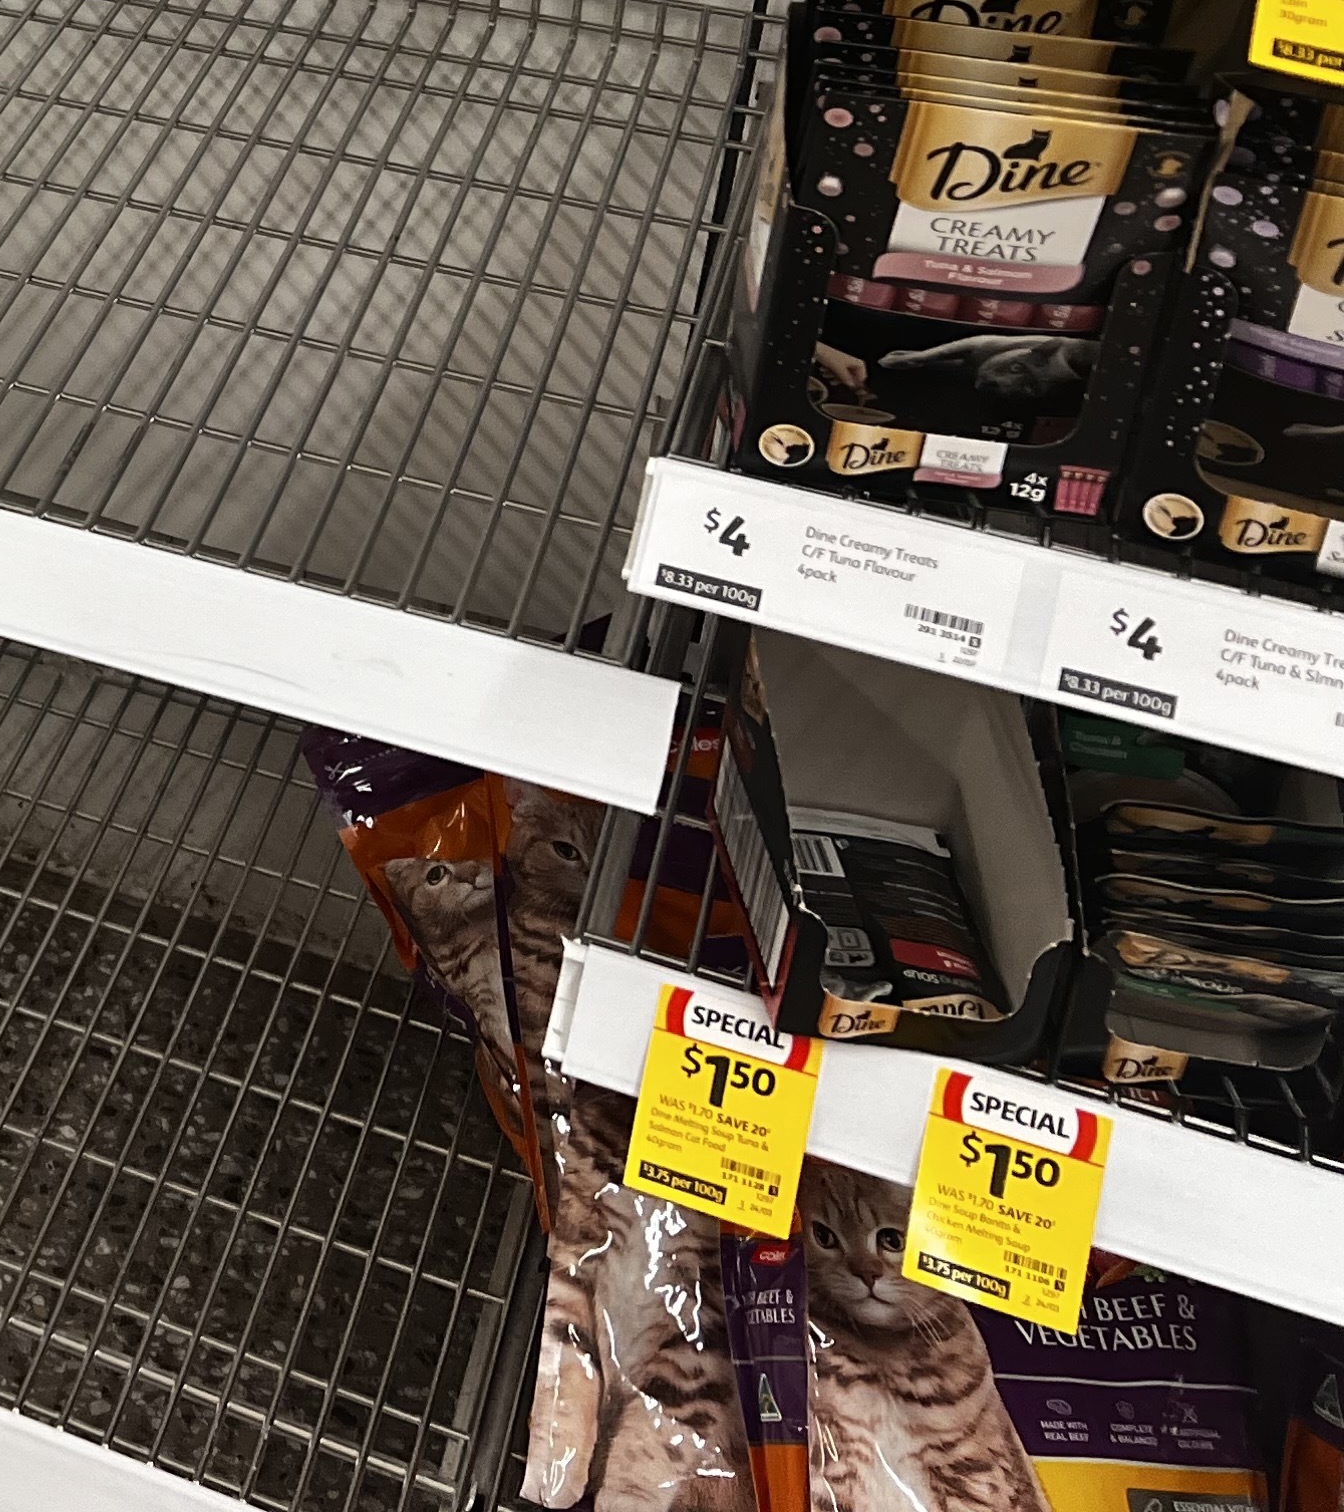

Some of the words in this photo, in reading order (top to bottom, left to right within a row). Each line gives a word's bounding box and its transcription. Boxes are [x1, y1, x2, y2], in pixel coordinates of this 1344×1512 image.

[927, 142, 1095, 201] Dine
[930, 217, 1055, 245] CREAMY
[938, 236, 1038, 262] TREATS
[840, 442, 906, 469] Dine
[1009, 483, 1046, 502] 12g
[1024, 472, 1048, 487] 4x
[703, 507, 751, 557] $4
[806, 526, 836, 544] Dine
[839, 534, 891, 559] Creamy
[896, 548, 938, 569] Treats
[1235, 518, 1306, 547] Dine
[797, 565, 837, 584] 4pack
[801, 544, 824, 560] C/F
[828, 549, 860, 569] Tuna
[863, 558, 916, 582] Flavour
[695, 577, 719, 595] per
[721, 584, 757, 609] 100g
[1110, 608, 1163, 661] $4
[1216, 669, 1260, 690] 4pack
[1220, 648, 1247, 665] C/F
[1250, 655, 1286, 675] Tuna
[1289, 665, 1301, 679] &
[1306, 669, 1344, 689] Slmn
[691, 1005, 786, 1050] SPECIAL
[829, 1014, 886, 1033] Dine
[970, 1091, 1070, 1140] SPECIAL
[648, 1120, 683, 1140] Salmon
[685, 1131, 701, 1145] Cat
[702, 1137, 726, 1152] Food
[671, 1173, 693, 1192] per
[694, 1179, 724, 1203] 100g
[921, 1255, 951, 1276] $3.75
[952, 1266, 974, 1283] per
[976, 1272, 1006, 1297] 100g
[1093, 1293, 1165, 1321] BEEF
[1177, 1294, 1196, 1320] &
